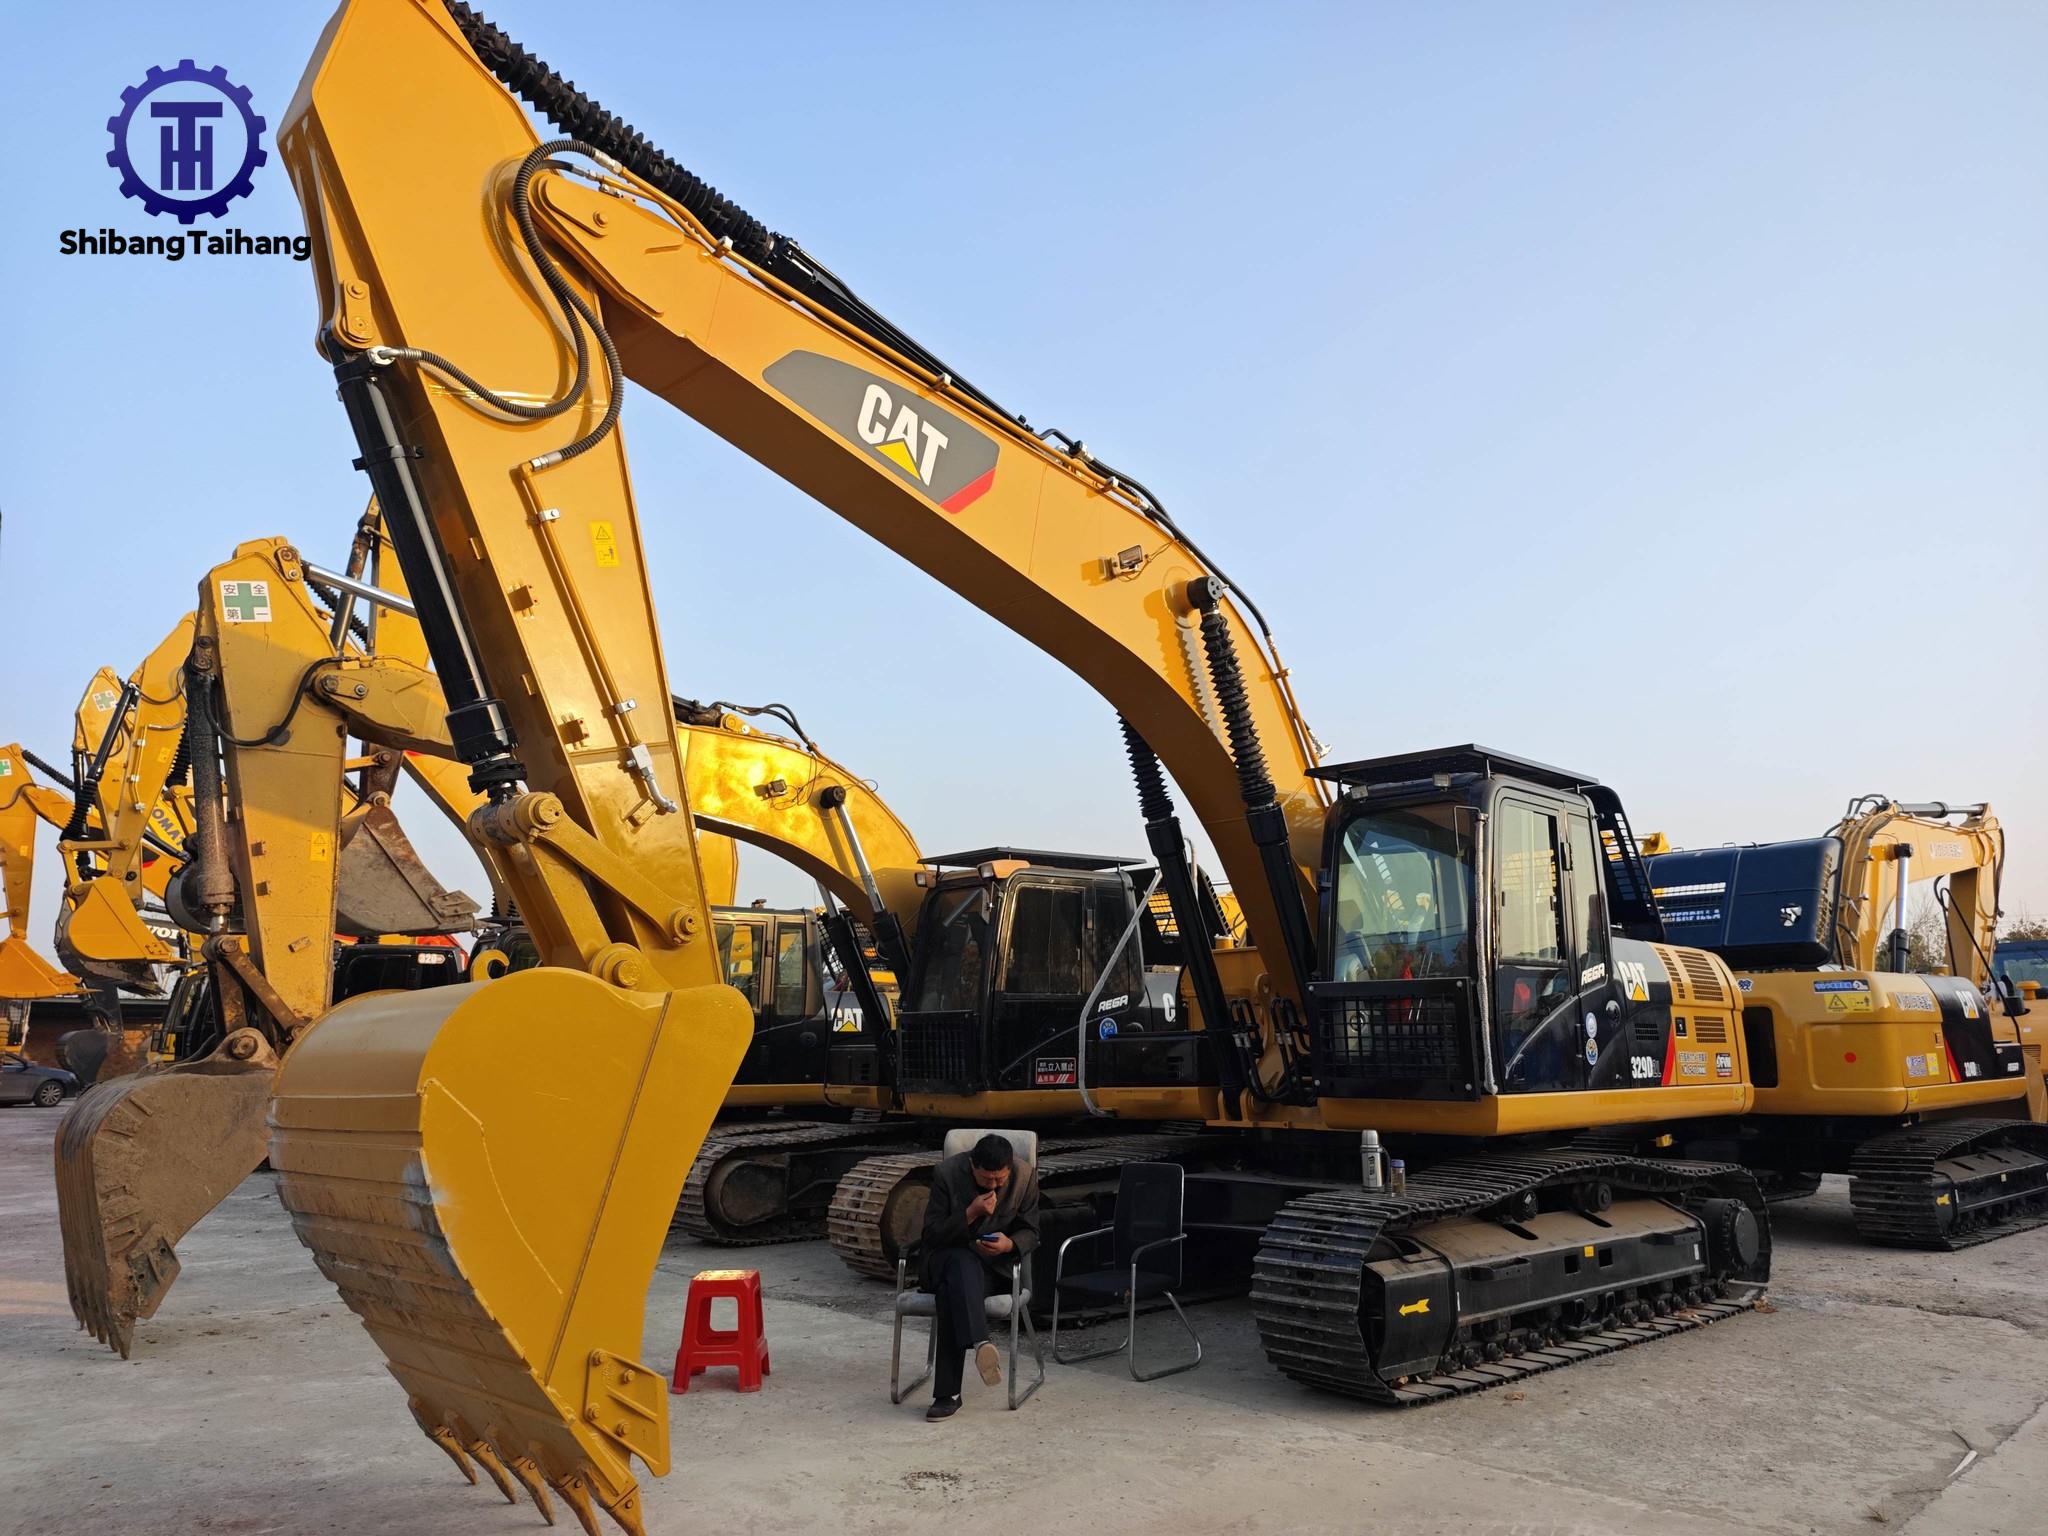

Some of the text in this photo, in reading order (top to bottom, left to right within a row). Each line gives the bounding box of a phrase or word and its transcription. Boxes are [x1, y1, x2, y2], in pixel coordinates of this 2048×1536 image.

[856, 383, 949, 487] CAT
[1618, 961, 1651, 1002] CAT
[1097, 994, 1129, 1013] REGA
[1162, 992, 1176, 1023] C
[830, 1007, 863, 1033] CAT
